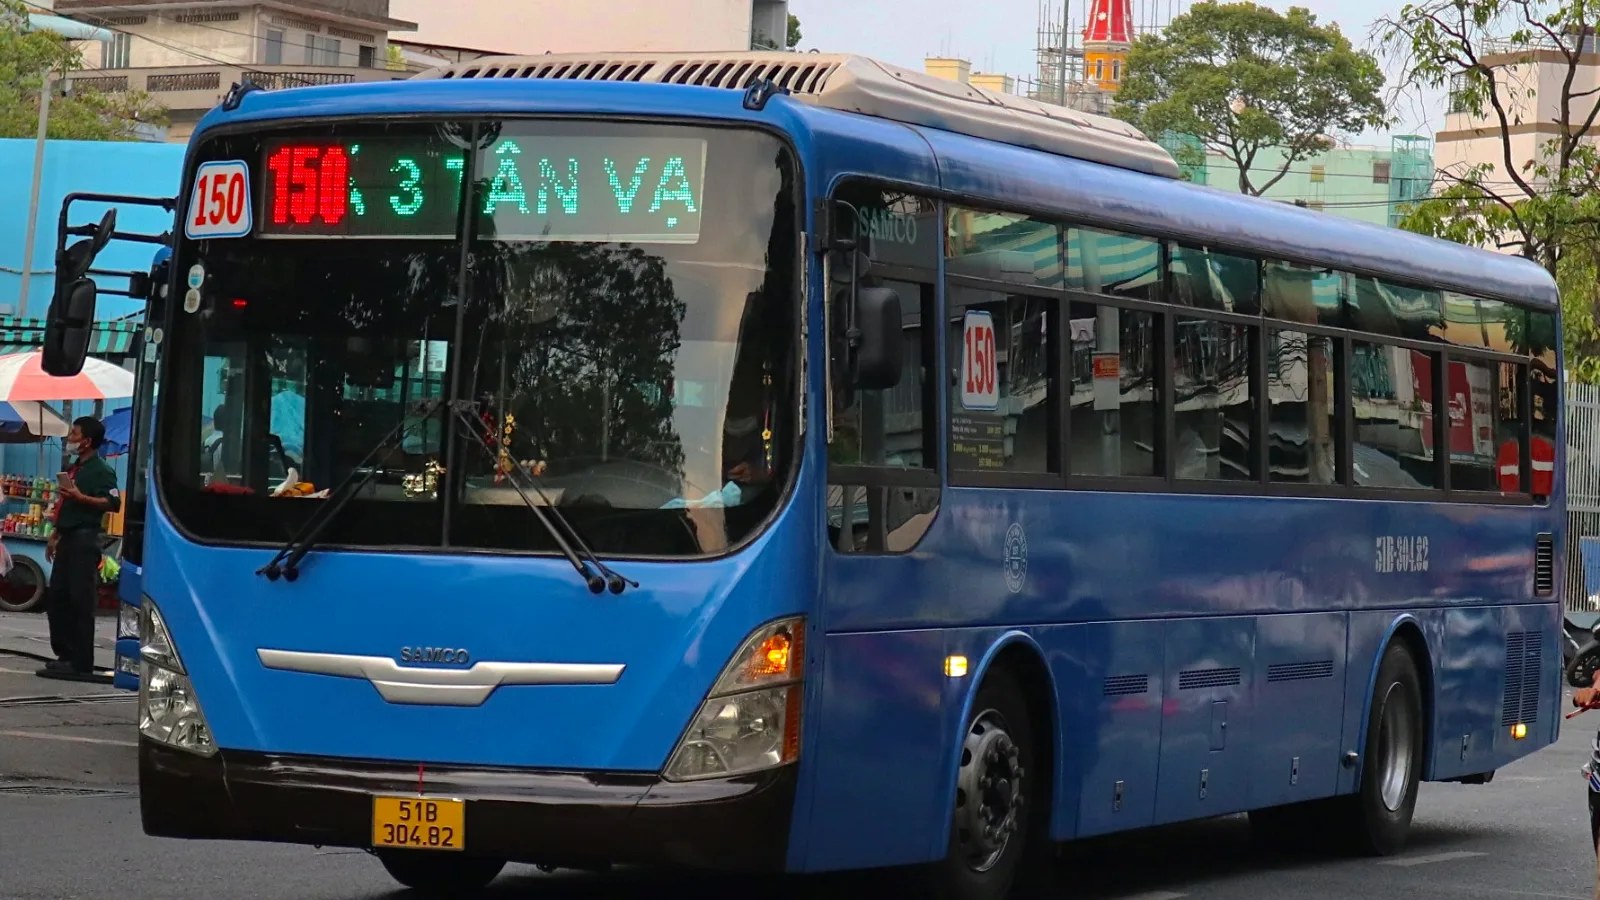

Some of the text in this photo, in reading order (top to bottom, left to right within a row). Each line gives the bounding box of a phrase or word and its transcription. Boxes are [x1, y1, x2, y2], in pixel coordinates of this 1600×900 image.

[195, 172, 244, 226] 150
[269, 145, 347, 224] 150
[390, 159, 423, 215] 3
[604, 157, 697, 228] VẠ
[859, 206, 917, 244] SAMCO
[965, 327, 994, 394] 150
[400, 646, 470, 664] SAMCO
[400, 801, 438, 822] 51B
[383, 823, 454, 847] 304.82
